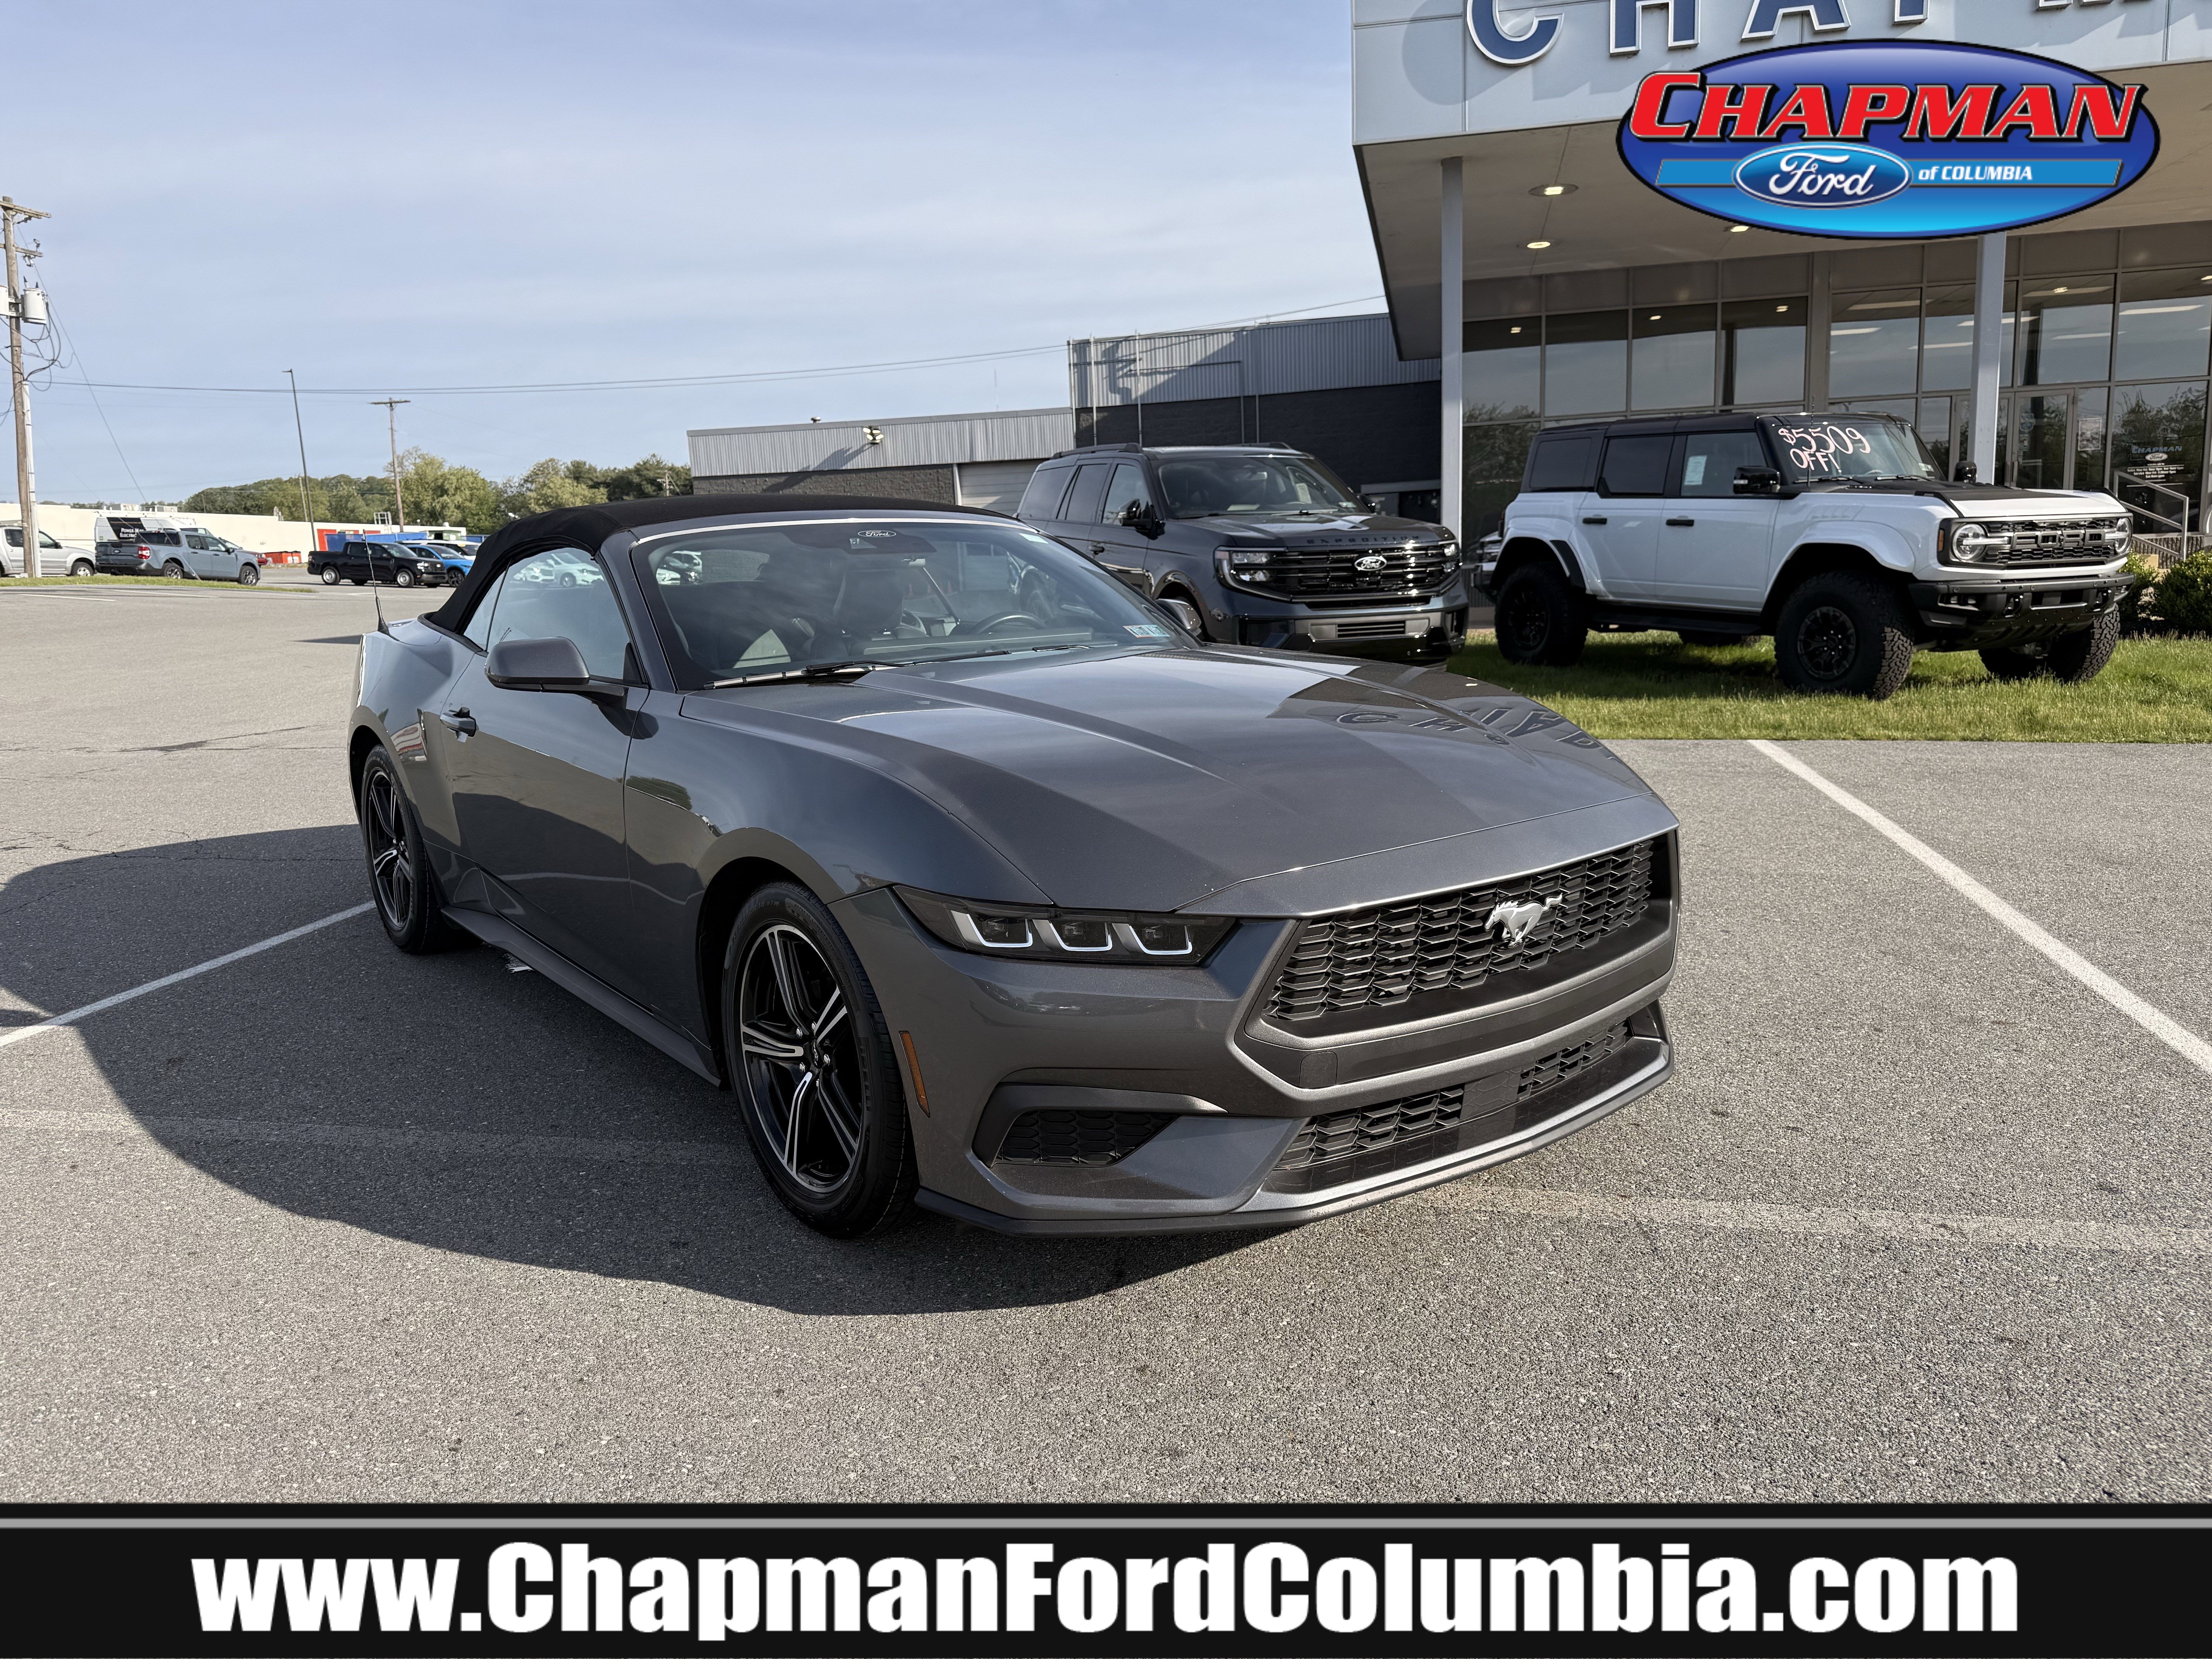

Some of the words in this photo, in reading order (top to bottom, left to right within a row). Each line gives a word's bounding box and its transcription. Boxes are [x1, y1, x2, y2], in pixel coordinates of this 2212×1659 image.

[1778, 426, 1871, 454] $5509
[2132, 445, 2182, 453] CHAPMAN
[1790, 448, 1842, 473] OFF!
[1307, 536, 1419, 544] EXPEDITION
[2013, 529, 2106, 549] FORD
